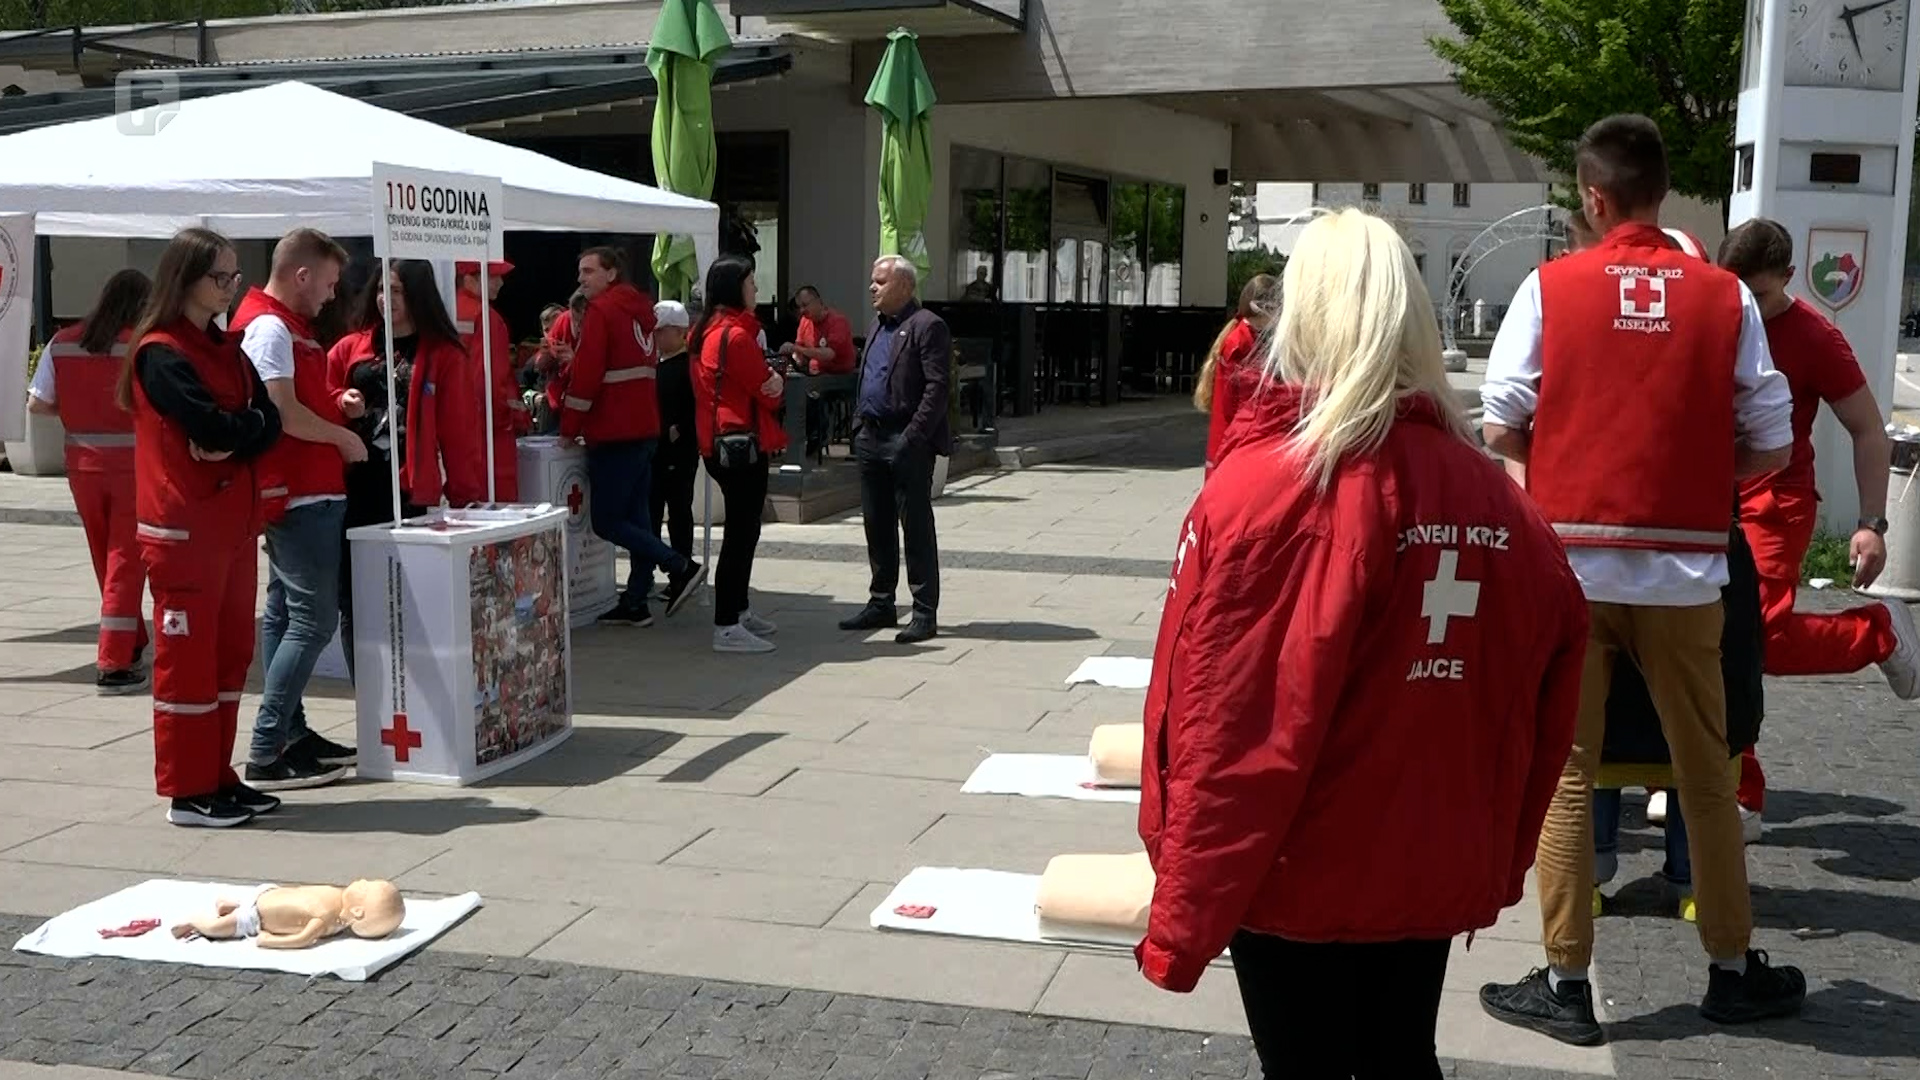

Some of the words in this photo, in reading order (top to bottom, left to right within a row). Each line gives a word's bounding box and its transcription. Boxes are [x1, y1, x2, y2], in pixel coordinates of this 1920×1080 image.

[1799, 4, 1807, 18] 9
[1838, 56, 1848, 73] 6
[386, 181, 416, 211] 110
[421, 186, 490, 216] GODINA
[387, 214, 421, 227] CRVENOG
[471, 220, 478, 231] U
[1605, 265, 1649, 277] CRVENI
[1613, 319, 1671, 333] KISELJAK
[1465, 526, 1510, 551] KRIŽ
[1406, 658, 1464, 681] JAJCE
